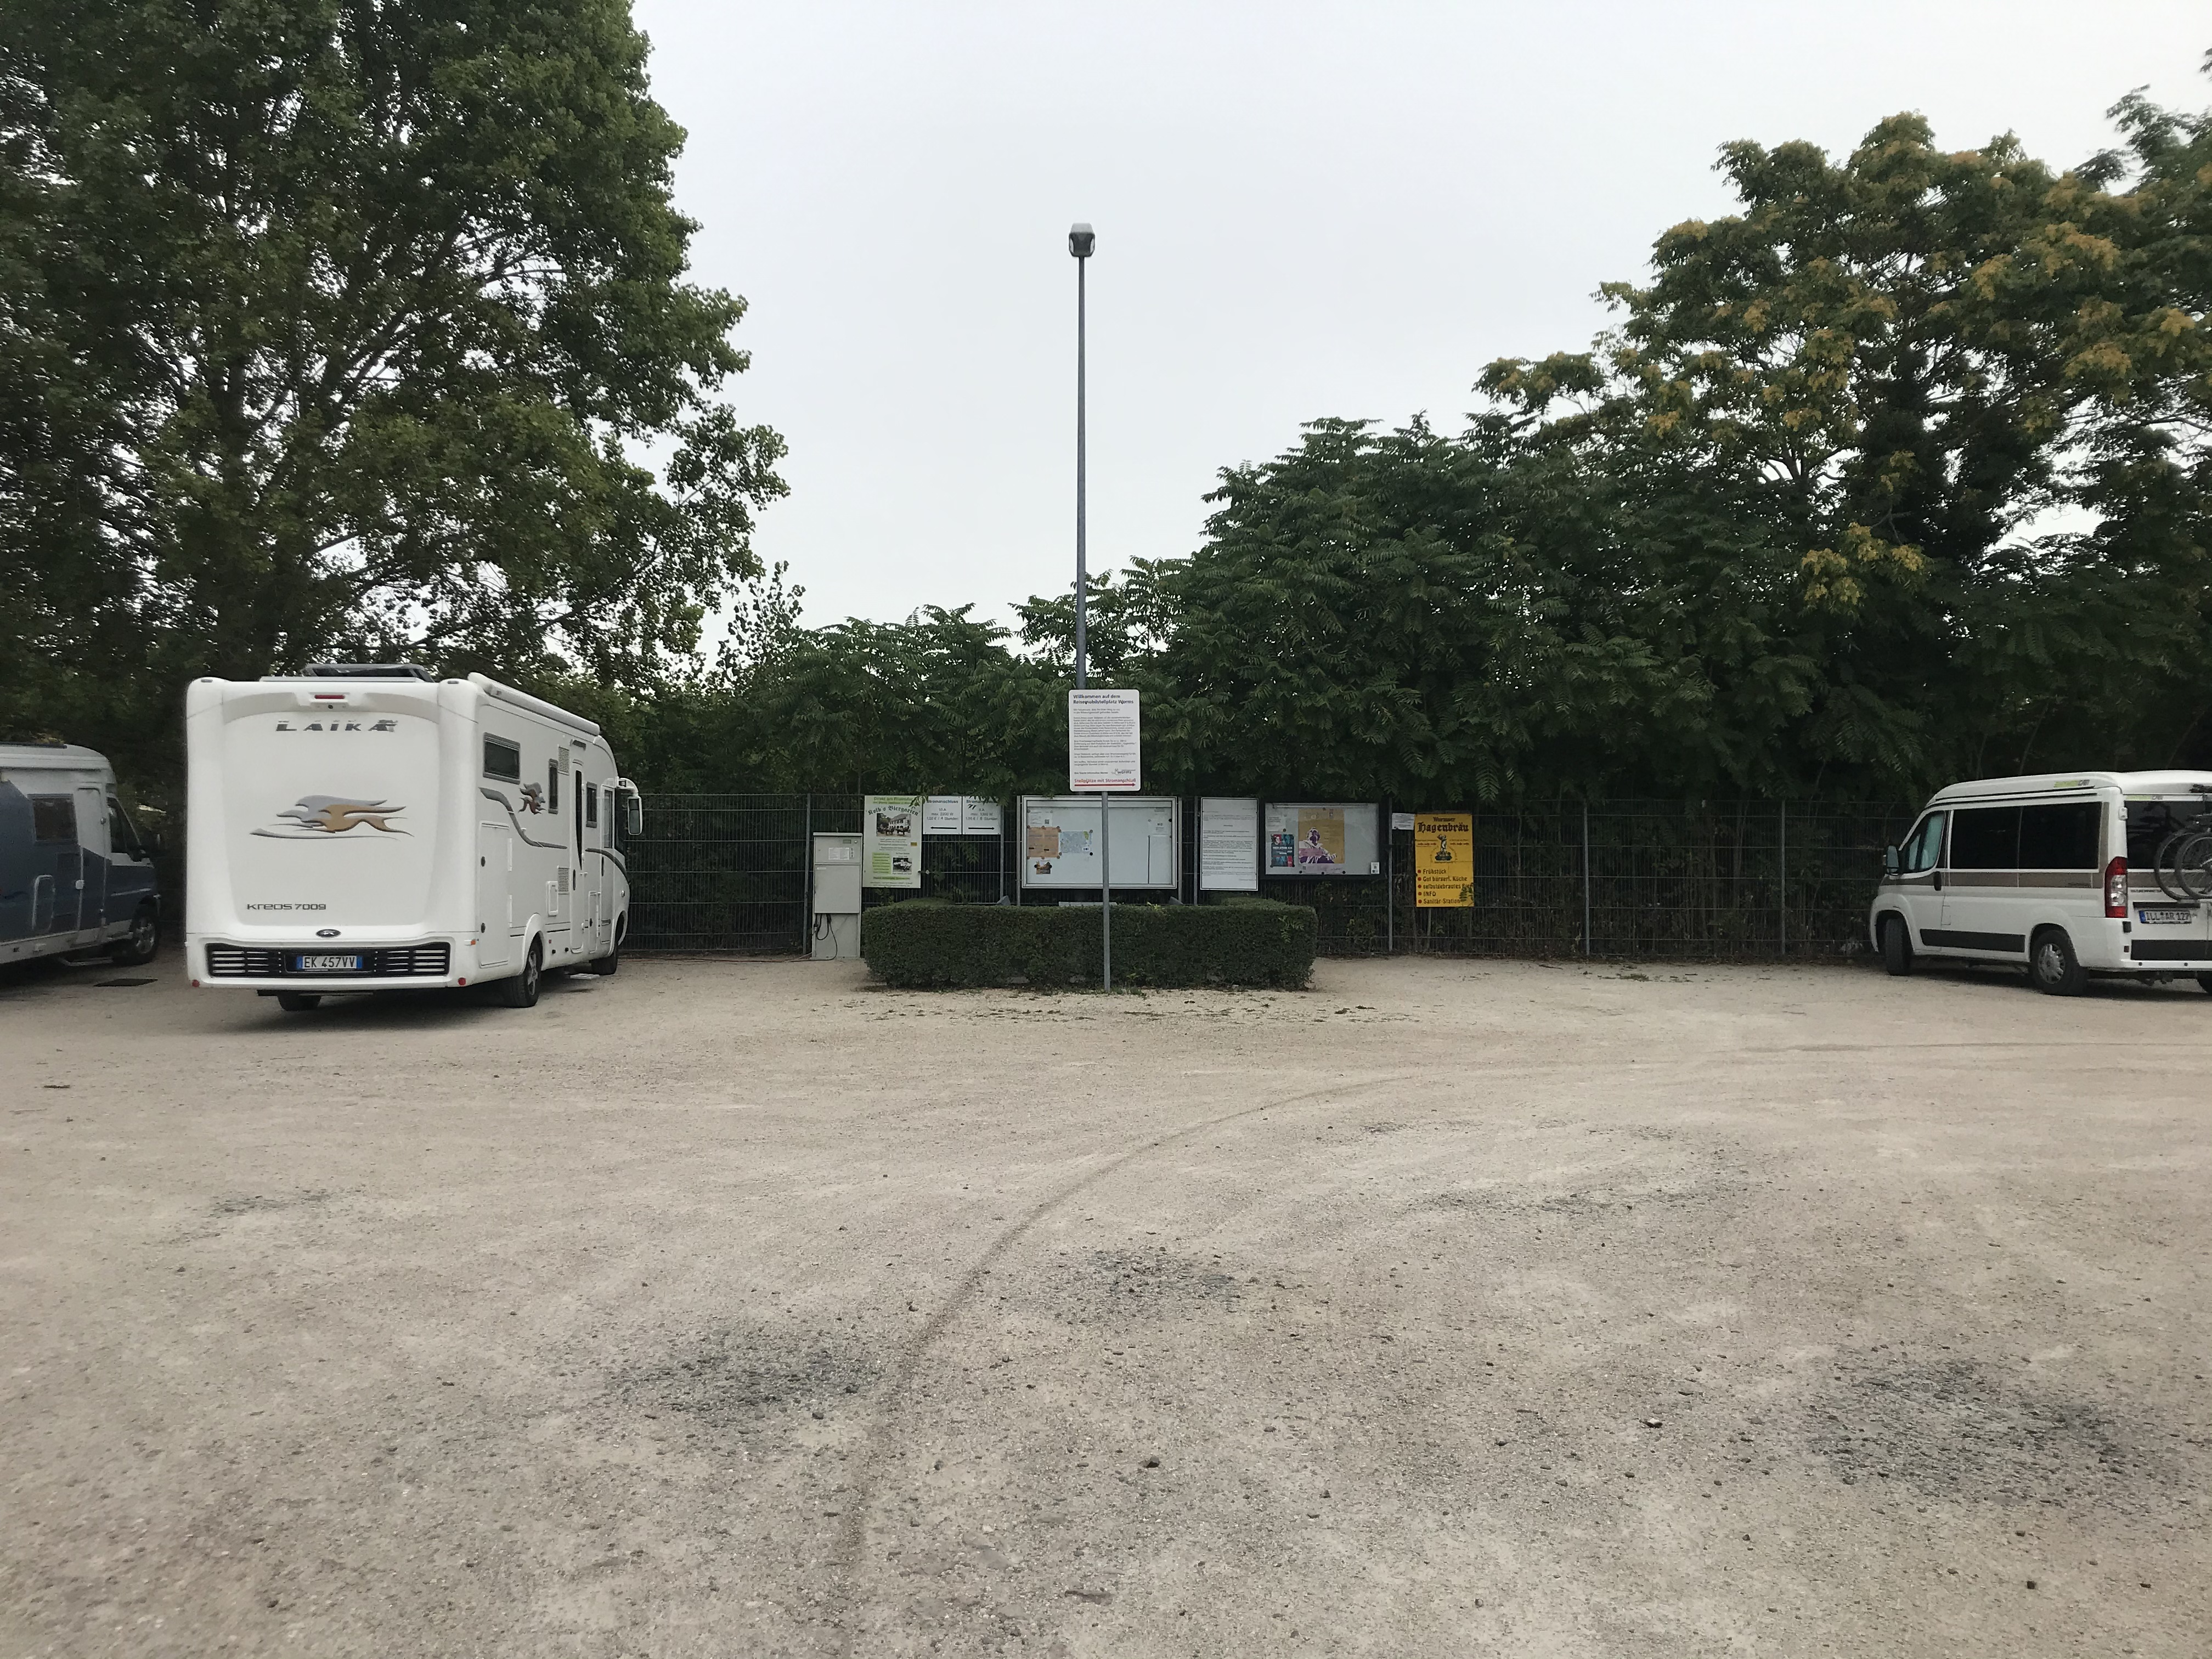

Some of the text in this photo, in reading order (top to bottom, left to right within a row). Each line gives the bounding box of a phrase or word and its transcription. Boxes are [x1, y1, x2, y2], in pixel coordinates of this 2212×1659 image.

[275, 719, 397, 732] LAIKA
[1417, 821, 1469, 833] Hagenbräu
[2146, 911, 2190, 921] ILL AR 127
[304, 956, 356, 968] EK 457VV
